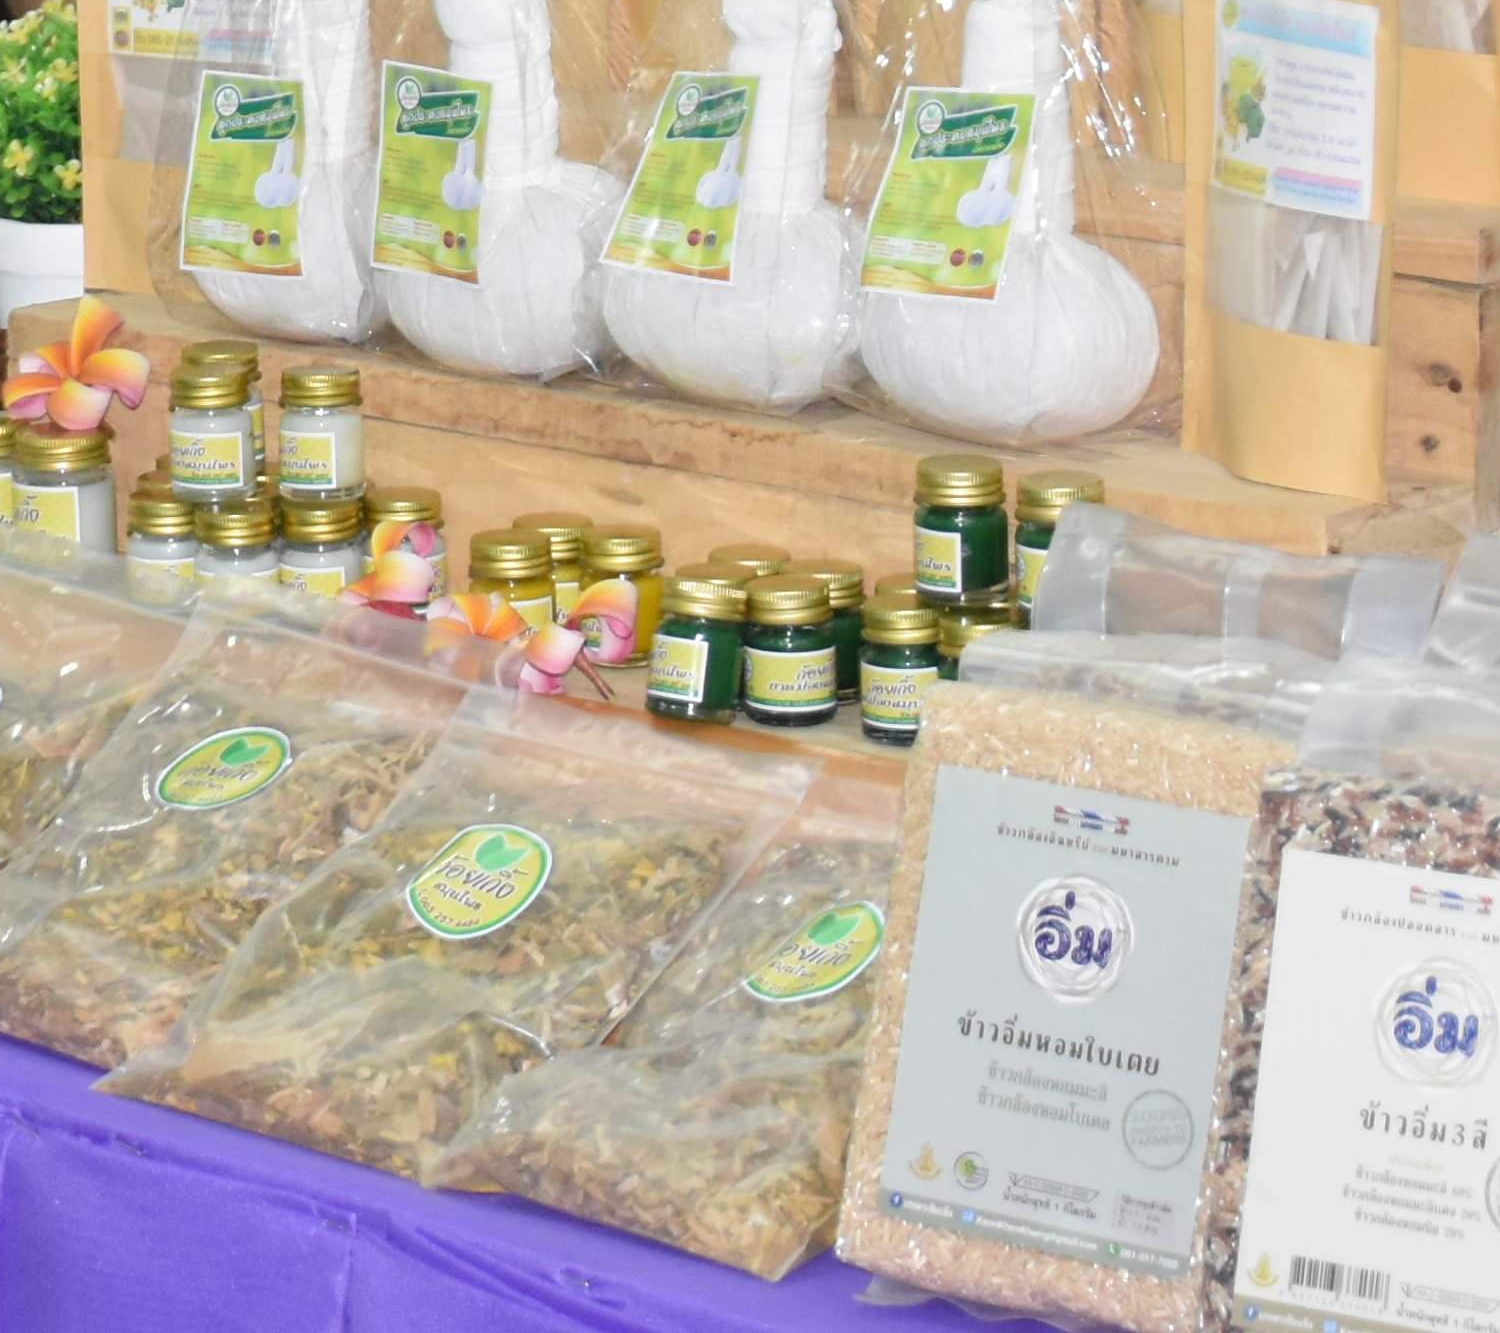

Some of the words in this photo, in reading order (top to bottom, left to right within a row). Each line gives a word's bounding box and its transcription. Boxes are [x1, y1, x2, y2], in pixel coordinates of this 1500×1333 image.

[1035, 891, 1112, 968] อิ่ม
[957, 1009, 1160, 1077] ข้าวอิ่มหอมใบเตย
[1394, 975, 1479, 1057] อิ่ม
